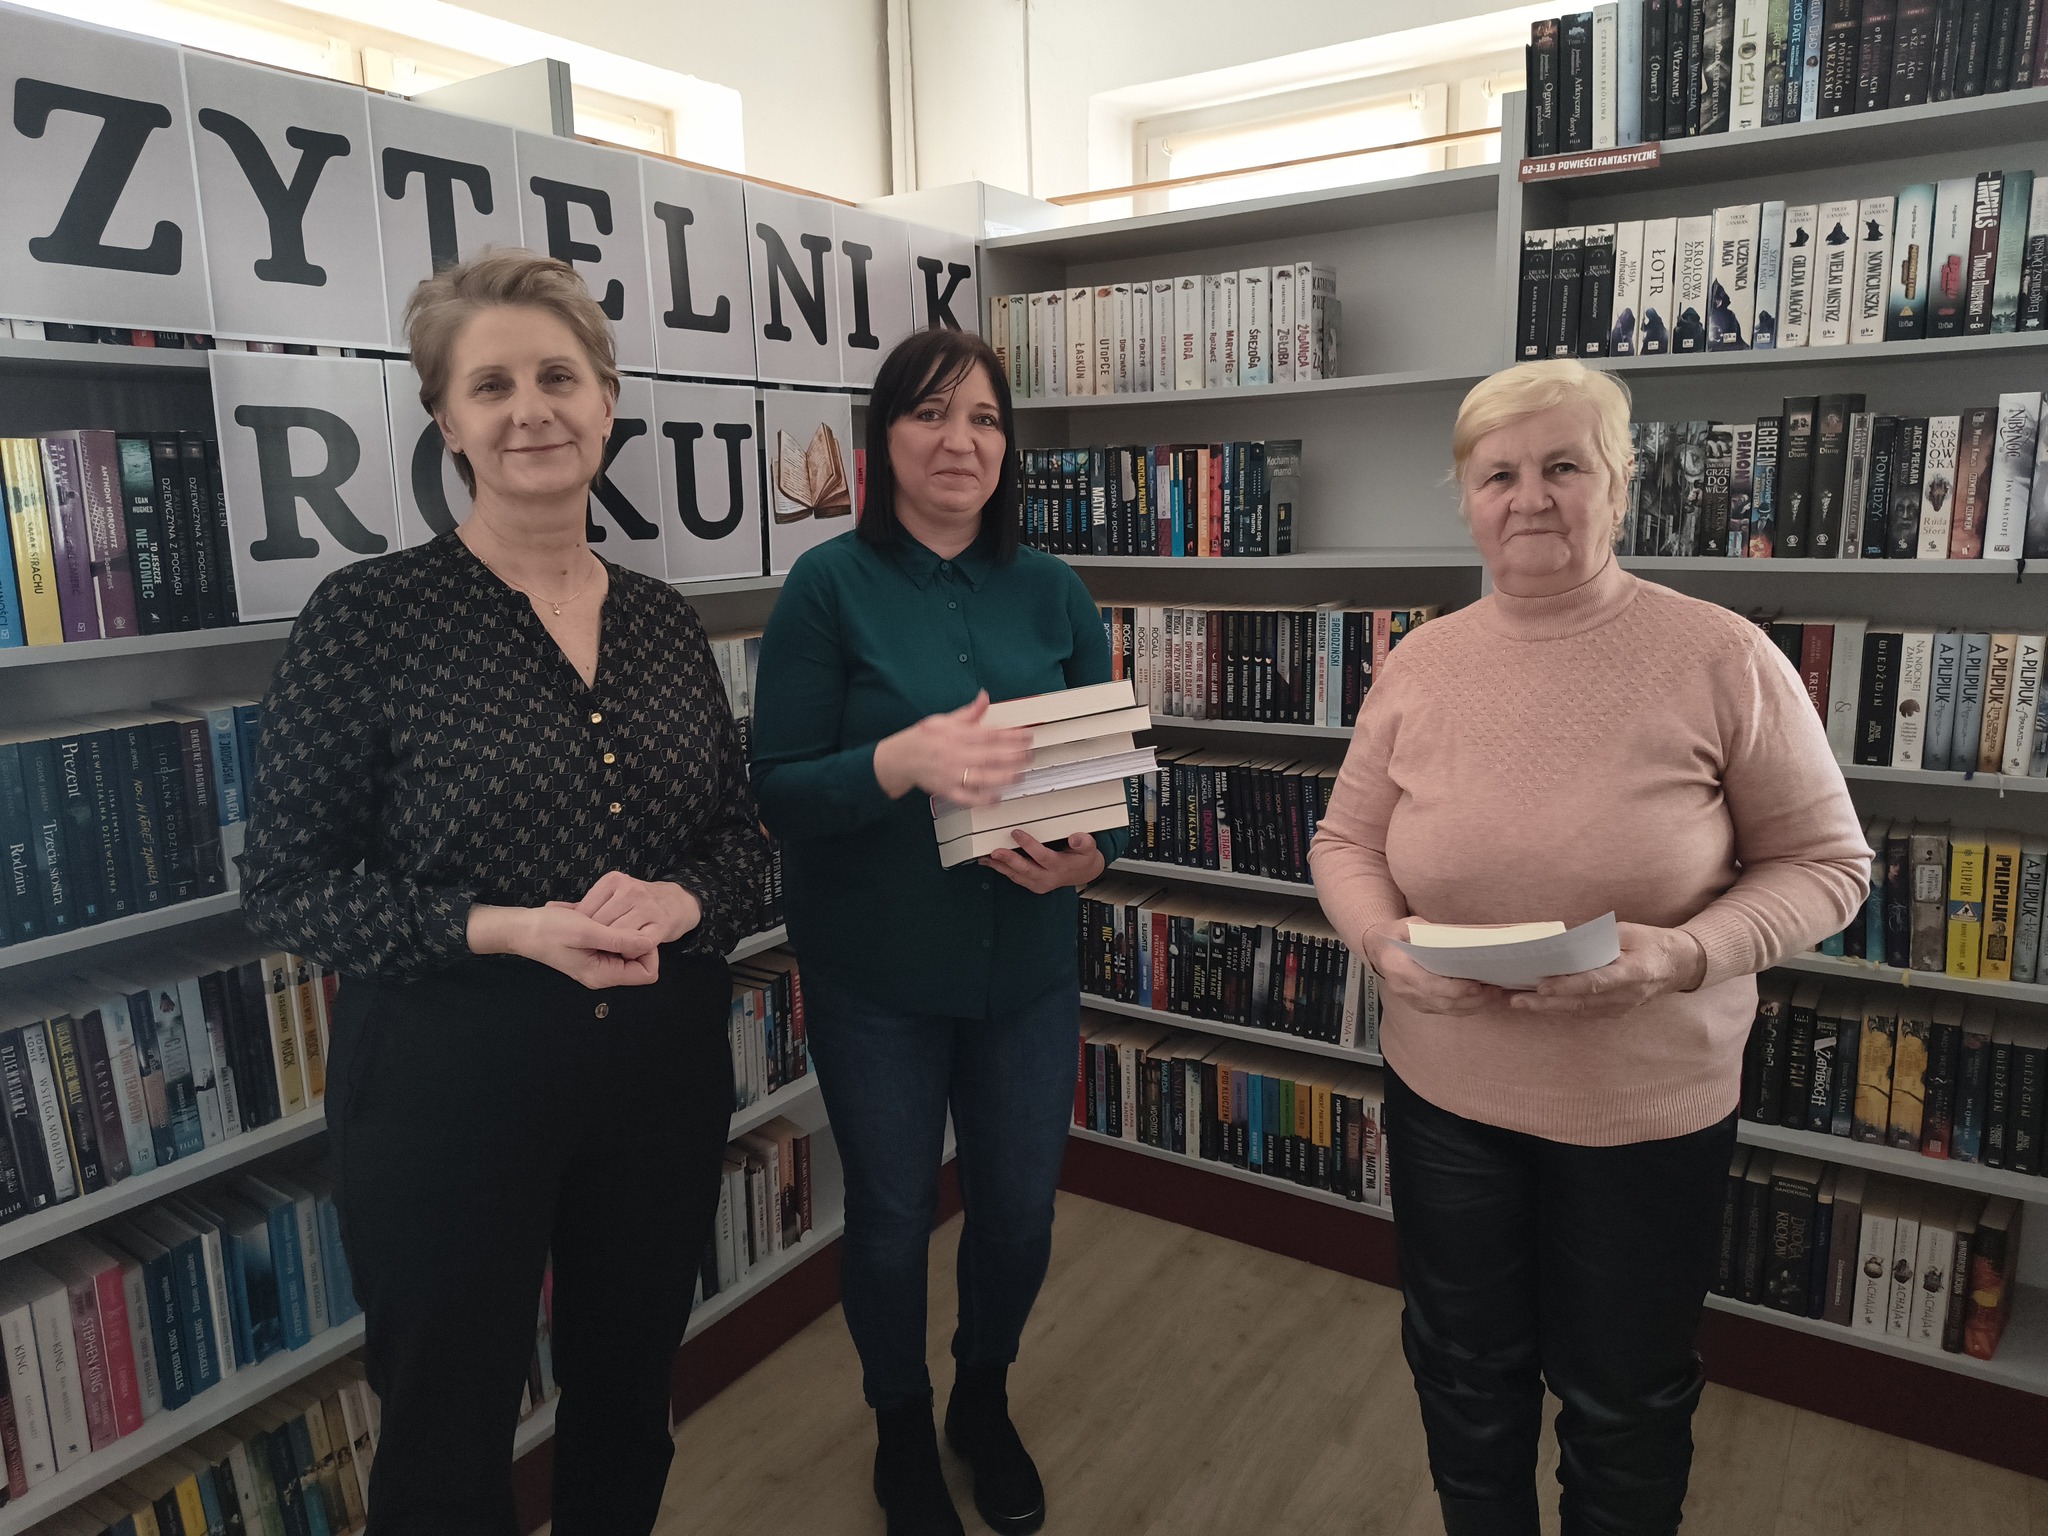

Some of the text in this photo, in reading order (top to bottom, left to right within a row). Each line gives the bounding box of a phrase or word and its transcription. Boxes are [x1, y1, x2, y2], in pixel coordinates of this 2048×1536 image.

[1691, 9, 1700, 58] Holly Black
[1792, 24, 1801, 43] FATE
[1808, 25, 1819, 49] DEAD
[1824, 42, 1836, 99] WRZASKU
[1522, 150, 1656, 174] 82-311.9 POWIEŚCI FANTASTYCZNE
[1975, 180, 2000, 228] IMPULS
[1617, 250, 1630, 297] Ambasadora
[1649, 249, 1666, 296] ŁOTR
[1691, 241, 1704, 300] KRÓLOWA
[1721, 240, 1734, 267] MAGA
[1735, 239, 1750, 291] UCZENNICA
[1788, 255, 1807, 326] GILDIA MAGÓW
[1824, 250, 1845, 322] WIELKI MISTRZ
[1863, 250, 1883, 319] NOWICJUSZKA
[1183, 333, 1194, 360] NORA
[1757, 428, 1778, 466] GREEN
[1909, 426, 1922, 484] JACEK PIEKARA
[1929, 438, 1956, 448] SAK
[1929, 448, 1955, 459] OW
[1931, 430, 1957, 438] KOS
[1266, 457, 1289, 466] Kocham
[1928, 459, 1954, 469] SKA
[101, 465, 118, 548] ANTHONY HOROWITZ
[1092, 487, 1105, 526] MATNIA
[1110, 479, 1118, 509] ZOSTAŃ
[1871, 455, 1888, 518] POMIĘDZY
[2000, 479, 2014, 537] JAY KRISTOFF
[161, 478, 176, 539] DZIEWCZYNA
[171, 553, 182, 595] POCIĄGU
[188, 477, 201, 537] DZIEWCZYNA
[196, 551, 208, 593] POCIĄGU
[29, 552, 43, 595] STRACHU
[135, 528, 154, 599] NIE KONIEC
[150, 542, 162, 584] TO JESZCZE
[1123, 624, 1131, 656] ROGALA
[1151, 627, 1159, 659] ROGALA
[1318, 617, 1326, 651] ROGOZIŃSKI
[1331, 622, 1341, 667] ROGOZIŃSKI
[1904, 646, 1915, 684] ZMIANIE
[1910, 640, 1925, 692] NA NOCNEJ
[61, 742, 82, 798] Prezent
[190, 728, 207, 806] OKRUTNE PRAGNIENIE
[1160, 767, 1173, 807] KARNAWAŁ
[1200, 774, 1208, 804] STACHULA
[91, 742, 117, 895] NIEWIDZIALNA DZIEWCZYNA
[108, 789, 120, 843] LISA JEWELL
[158, 752, 179, 871] IDEALNA RODZINA
[1187, 795, 1197, 851] UWIKŁANA
[1203, 810, 1213, 854] IDEALNA
[41, 819, 65, 905] Trzecia siostra
[1221, 829, 1230, 860] STRACH
[9, 843, 29, 896] Rodzina
[1959, 861, 1971, 897] PILIPIUK
[1102, 926, 1112, 942] NIC
[1193, 964, 1201, 999] WAKACJE
[1344, 1010, 1355, 1035] ŻONA
[27, 1036, 38, 1063] KONIK
[35, 1034, 47, 1064] ROMAN
[56, 1023, 76, 1056] IDEALNE
[67, 1079, 83, 1105] MOLLY
[281, 1038, 296, 1070] MOCK
[1938, 1030, 1949, 1076] ANDY WEIR
[0, 1045, 28, 1119] DZIENNIKARZ
[37, 1077, 55, 1122] WSTĘGA
[95, 1060, 114, 1122] KAPŁAN
[123, 1076, 141, 1125] TERAPEUTKI
[1221, 1071, 1229, 1119] POD KLUCZEM
[1366, 1156, 1376, 1189] MARTWA
[12, 1346, 29, 1376] KING
[52, 1342, 67, 1373] KING
[80, 1317, 104, 1393] STEPHEN KING
